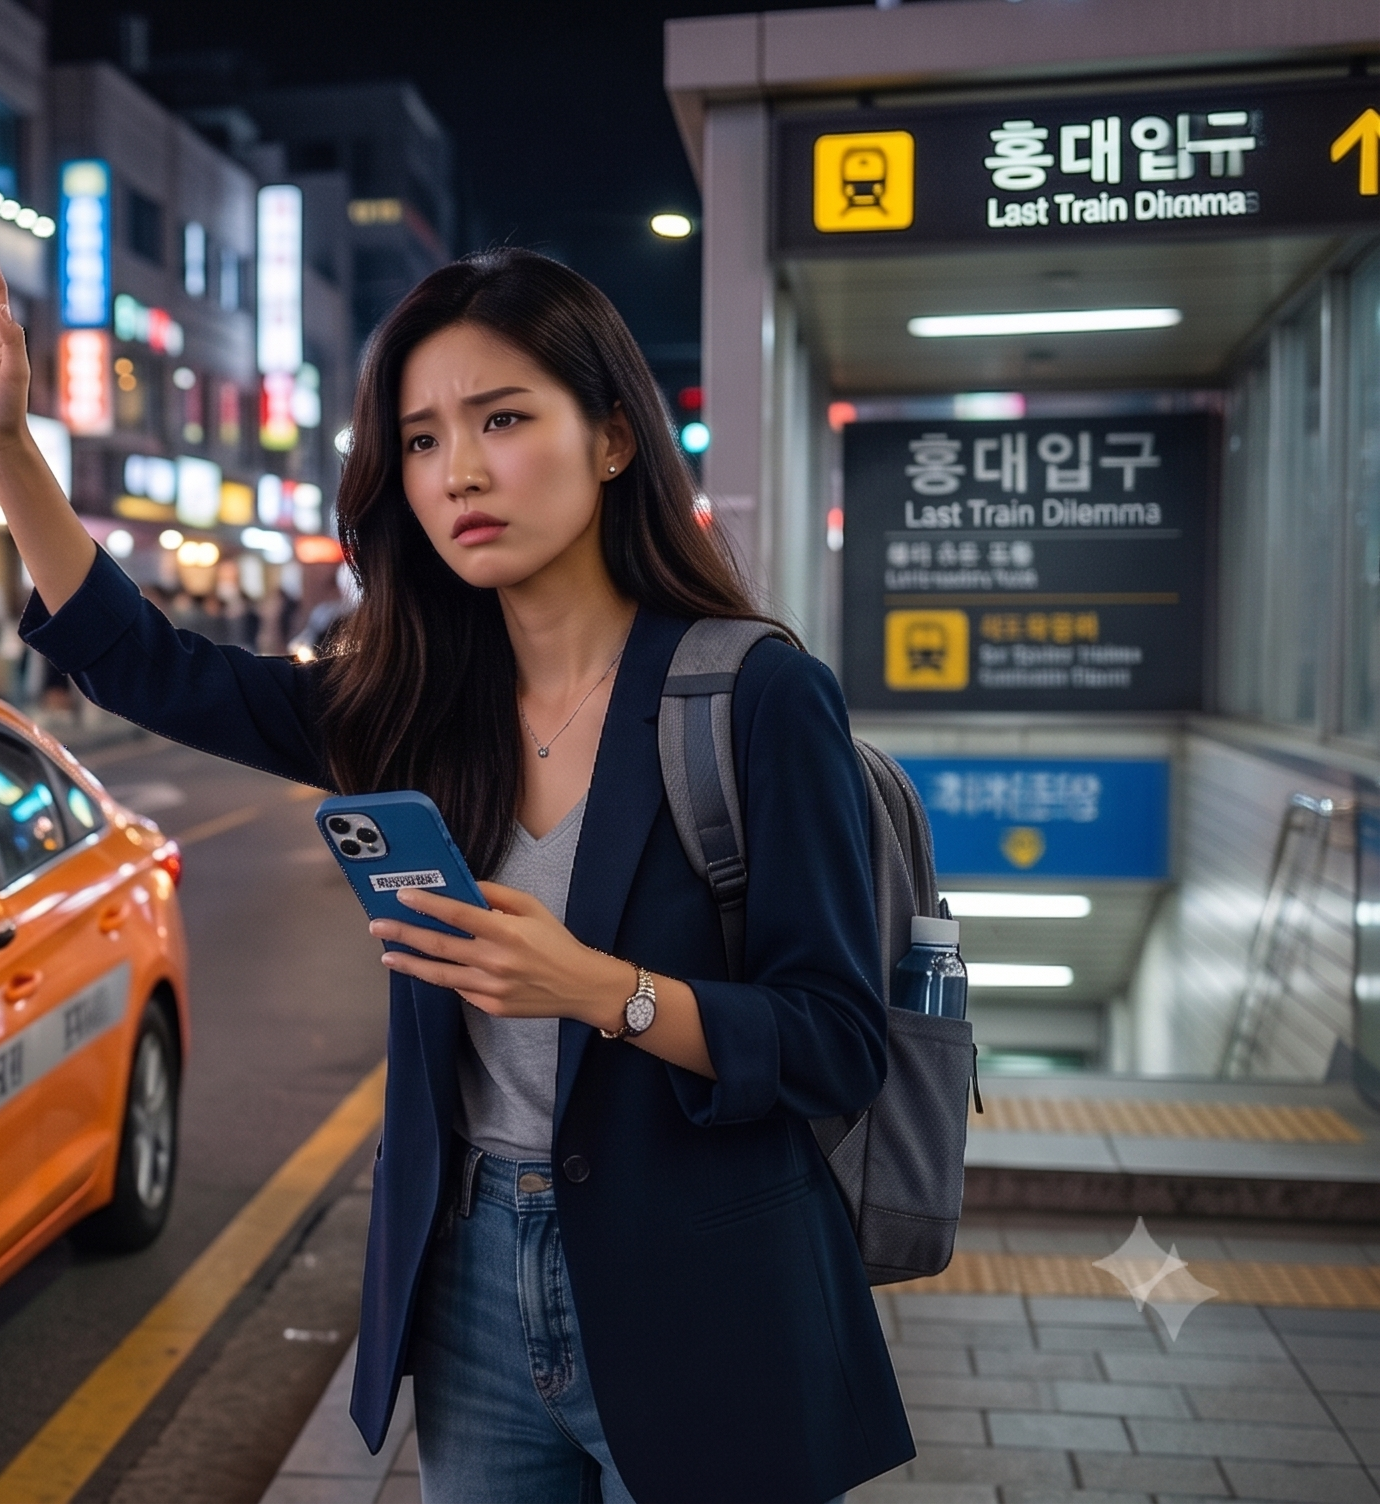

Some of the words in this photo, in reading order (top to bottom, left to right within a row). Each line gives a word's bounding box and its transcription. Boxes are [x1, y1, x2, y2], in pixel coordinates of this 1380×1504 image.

[986, 197, 1049, 228] Last
[1053, 192, 1128, 225] Train
[904, 430, 1162, 496] 홍대입구
[905, 500, 962, 529] Last
[966, 498, 1036, 528] Train
[1041, 498, 1163, 528] Dilemma
